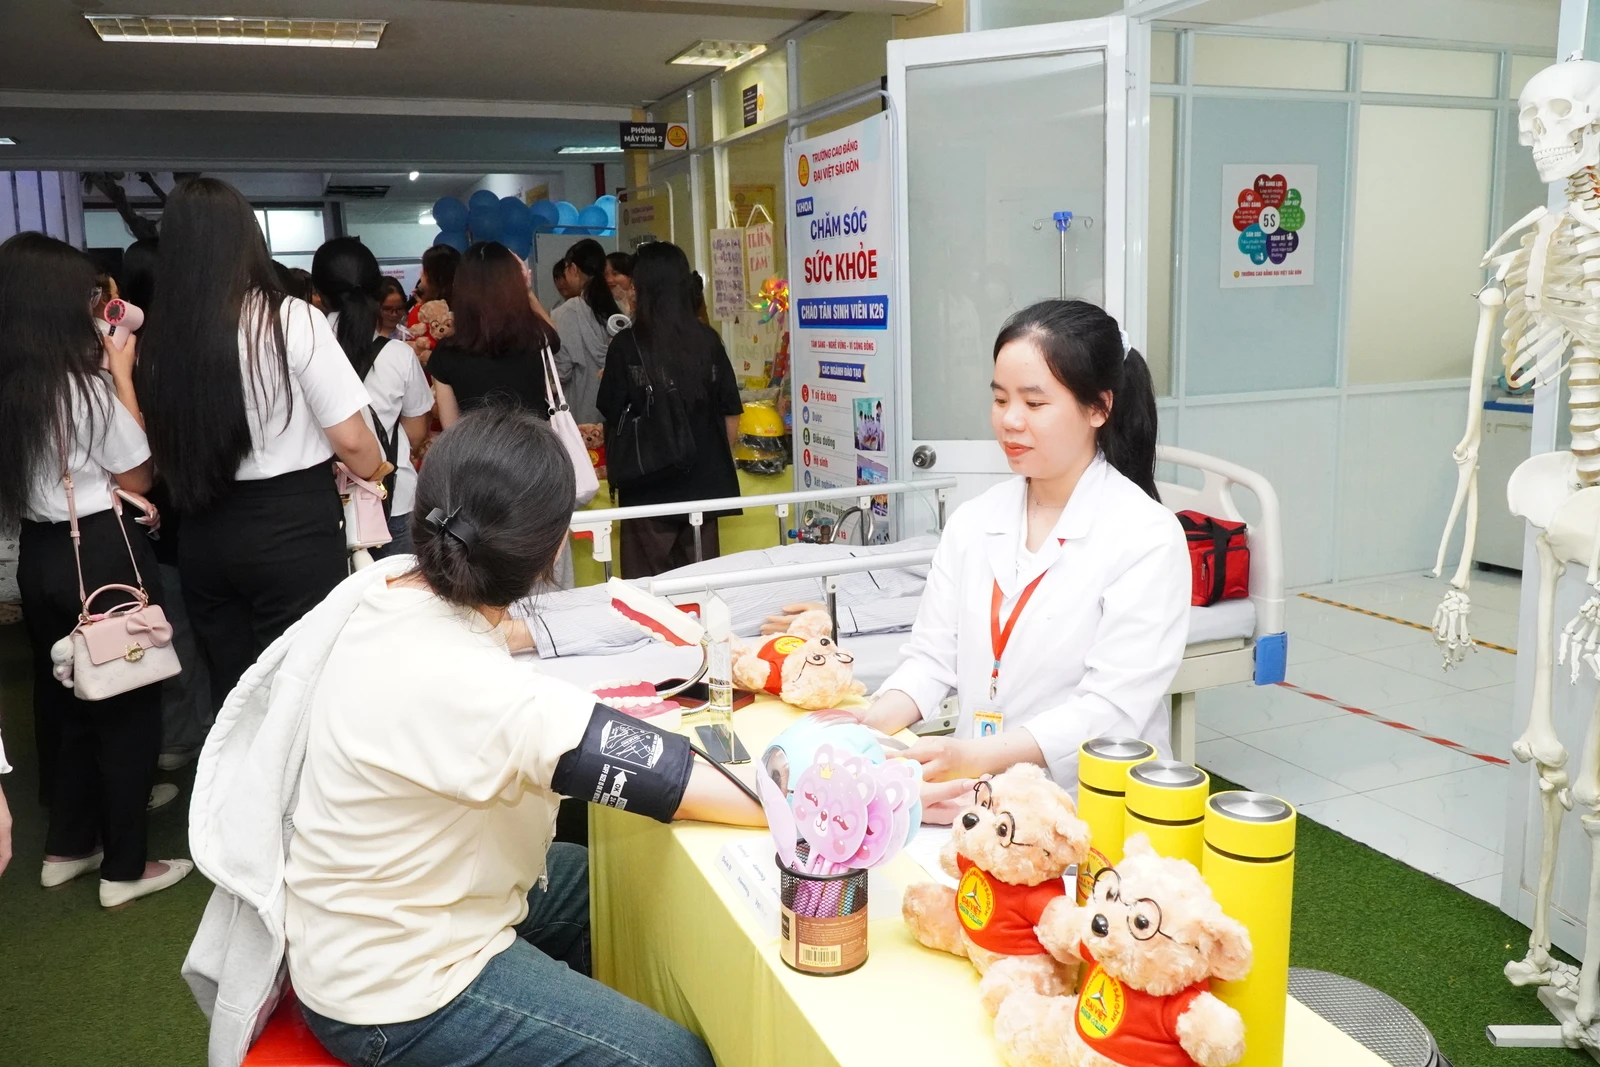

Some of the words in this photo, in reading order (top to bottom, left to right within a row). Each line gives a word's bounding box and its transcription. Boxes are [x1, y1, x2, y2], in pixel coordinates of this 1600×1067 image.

[812, 148, 831, 163] TRƯỜNG
[832, 146, 842, 157] CAO
[843, 139, 858, 154] ĐẲNG
[814, 170, 823, 183] ĐẠI
[823, 164, 835, 182] VIỆT
[835, 161, 845, 176] SÀI
[846, 158, 860, 173] GÒN
[797, 201, 812, 214] KHOA
[810, 212, 841, 240] CHĂM
[844, 206, 867, 234] SÓC
[1264, 214, 1276, 227] 5S
[805, 249, 832, 283] SỨC
[836, 242, 877, 281] KHỎE
[801, 302, 818, 319] CHÀO
[819, 301, 831, 319] TÂN
[833, 304, 849, 319] SINH
[851, 300, 867, 319] VIÊN
[870, 303, 884, 319] K26
[811, 389, 815, 399] Y
[820, 390, 825, 400] đa
[827, 392, 837, 402] khoa
[820, 458, 828, 468] sinh
[613, 783, 621, 792] OK
